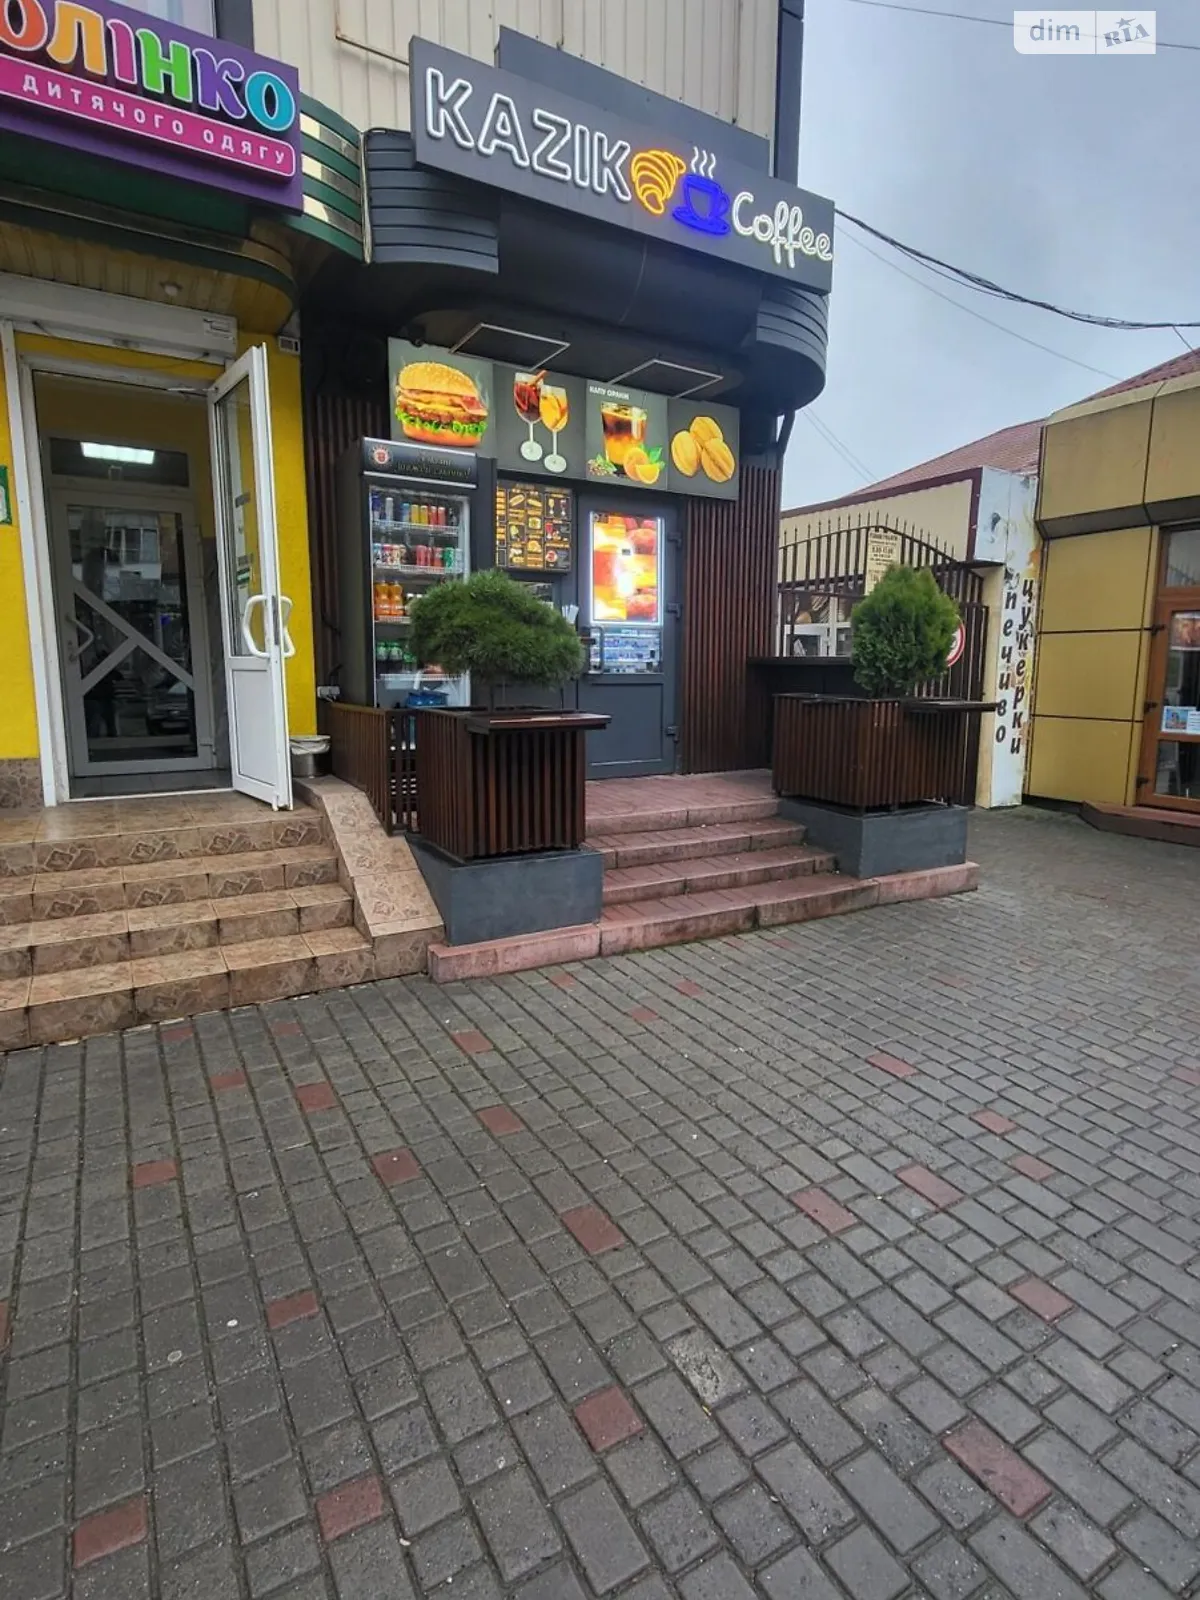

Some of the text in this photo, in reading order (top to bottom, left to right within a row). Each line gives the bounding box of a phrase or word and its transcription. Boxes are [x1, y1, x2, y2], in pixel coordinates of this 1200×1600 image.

[22, 73, 285, 165] ДИТЯЧОГО ОДЯГУ
[425, 67, 833, 269] KAZIK Coffee
[995, 591, 1018, 744] печиво
[1010, 578, 1034, 755] цукерки
